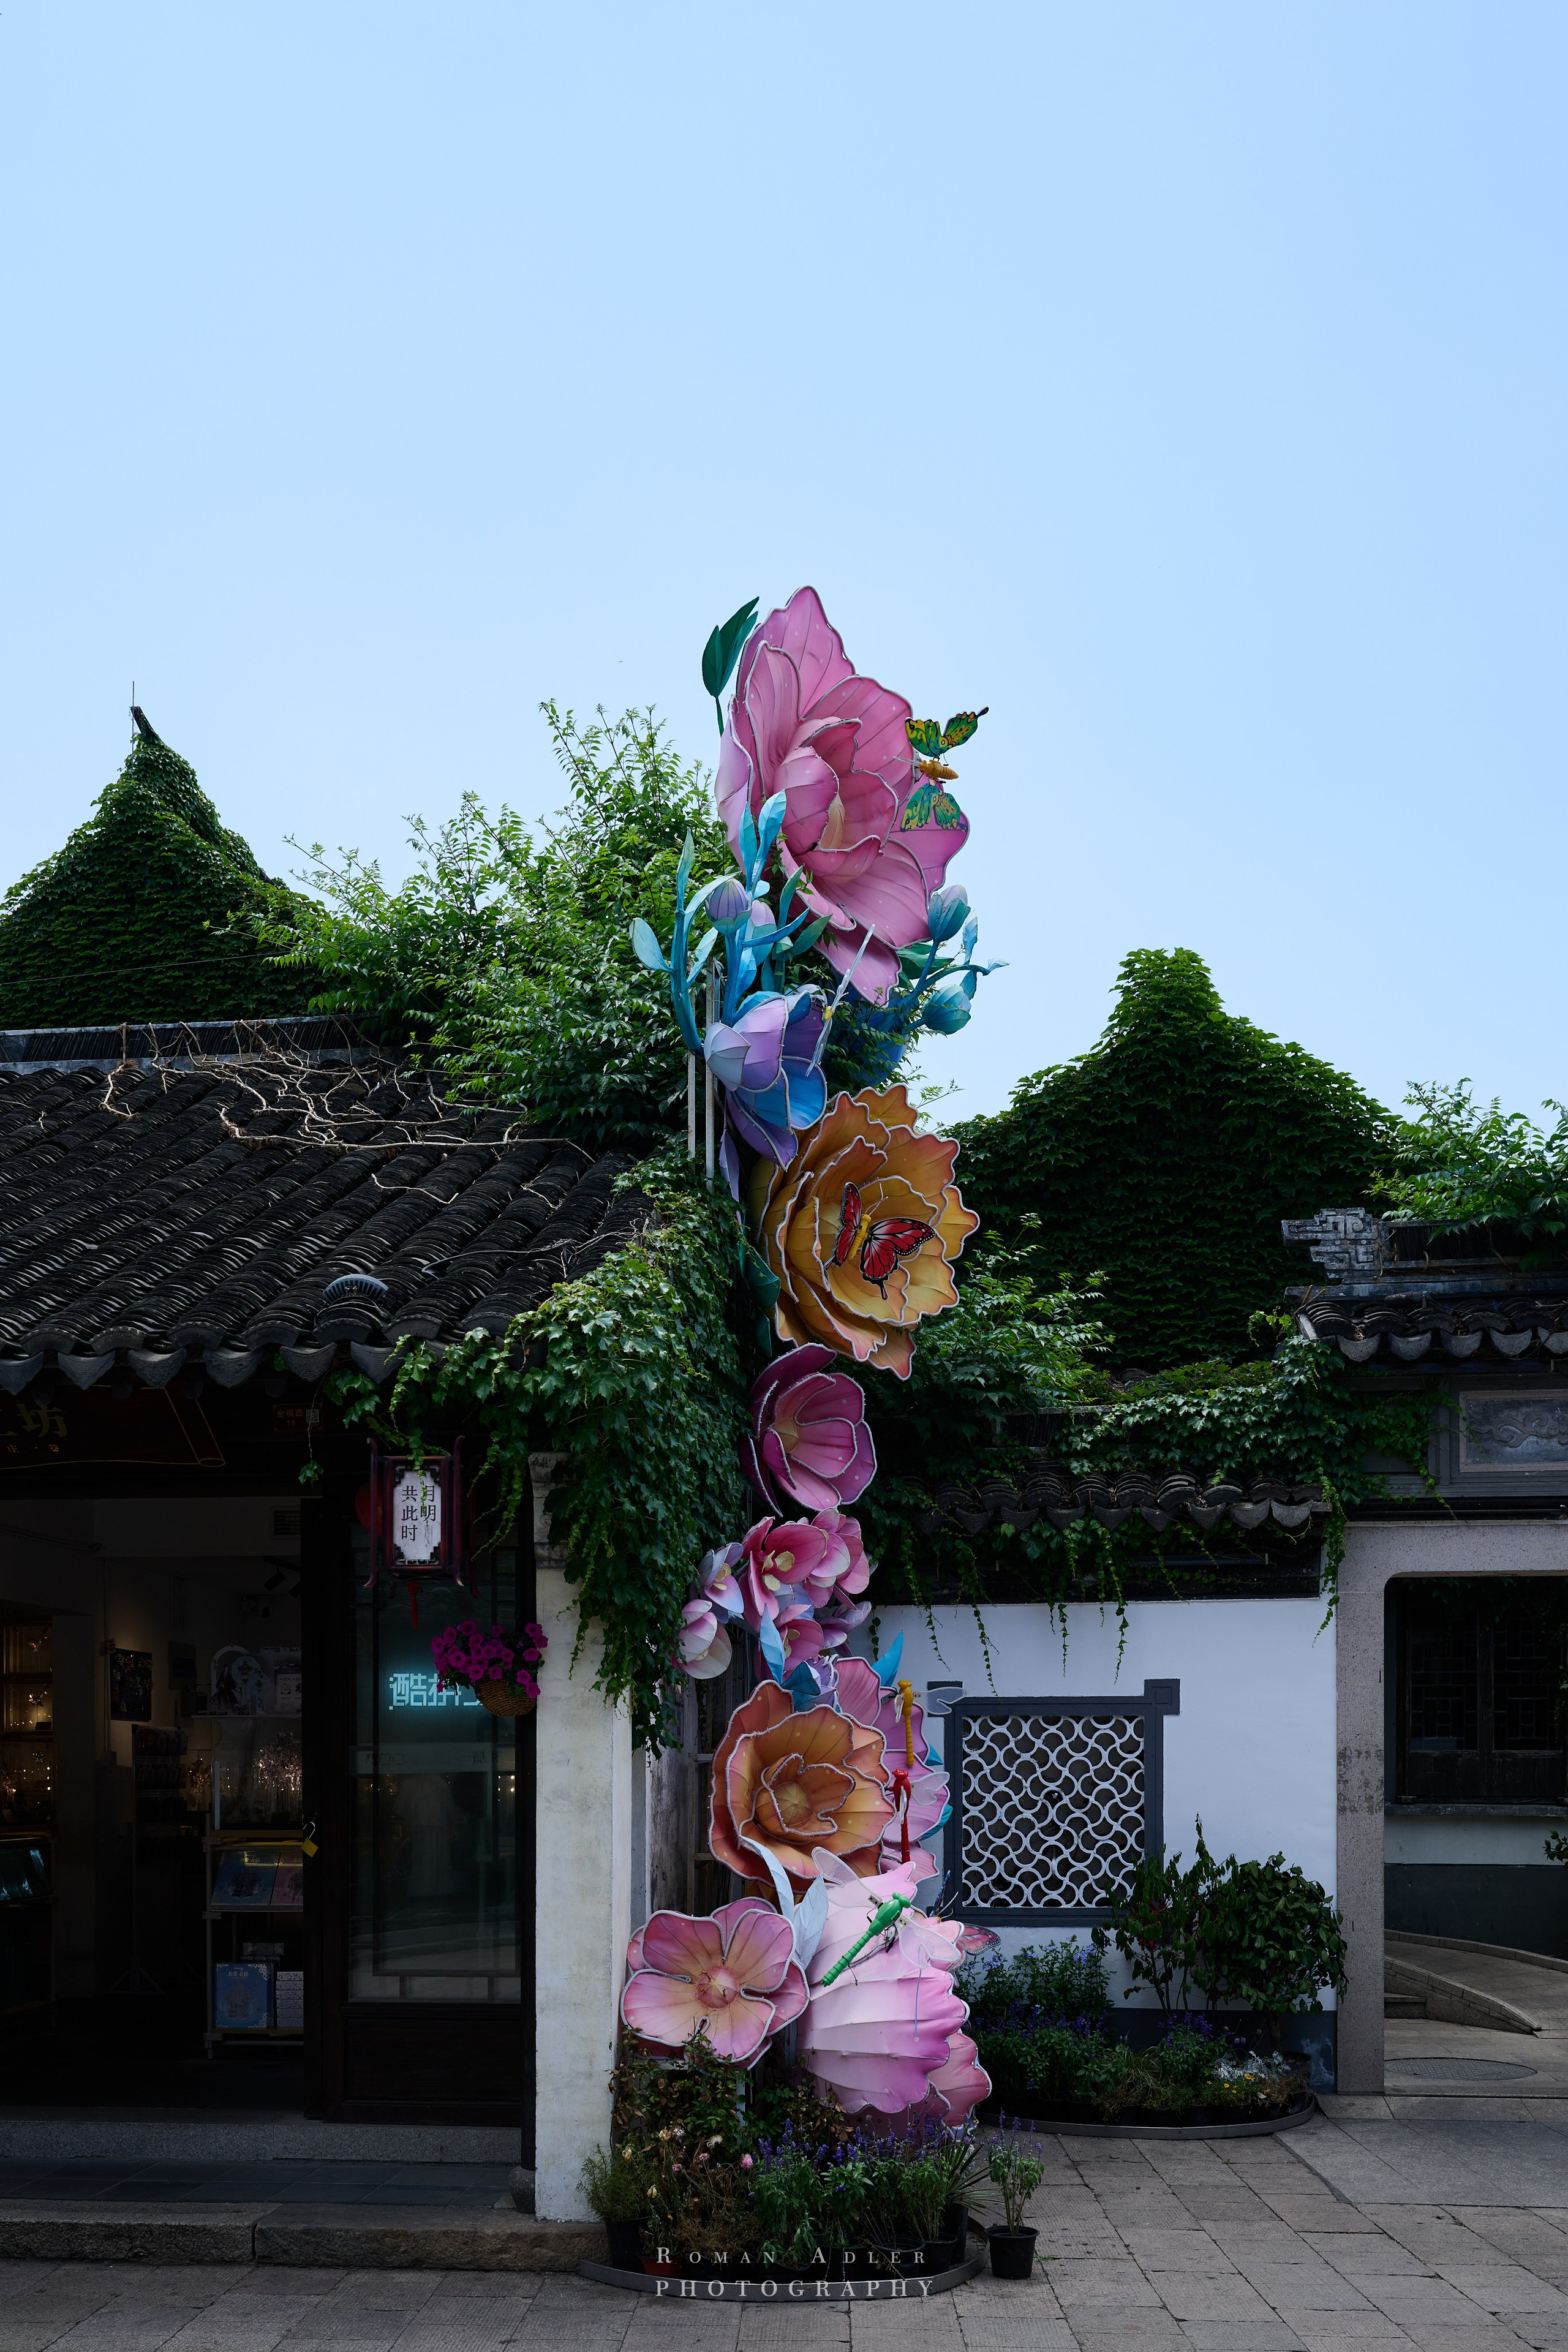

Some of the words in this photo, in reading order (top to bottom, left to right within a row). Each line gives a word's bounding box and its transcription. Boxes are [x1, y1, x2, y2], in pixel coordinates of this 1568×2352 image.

[276, 1409, 303, 1418] 全福路
[401, 1485, 418, 1542] 共此时
[420, 1485, 436, 1521] 月明
